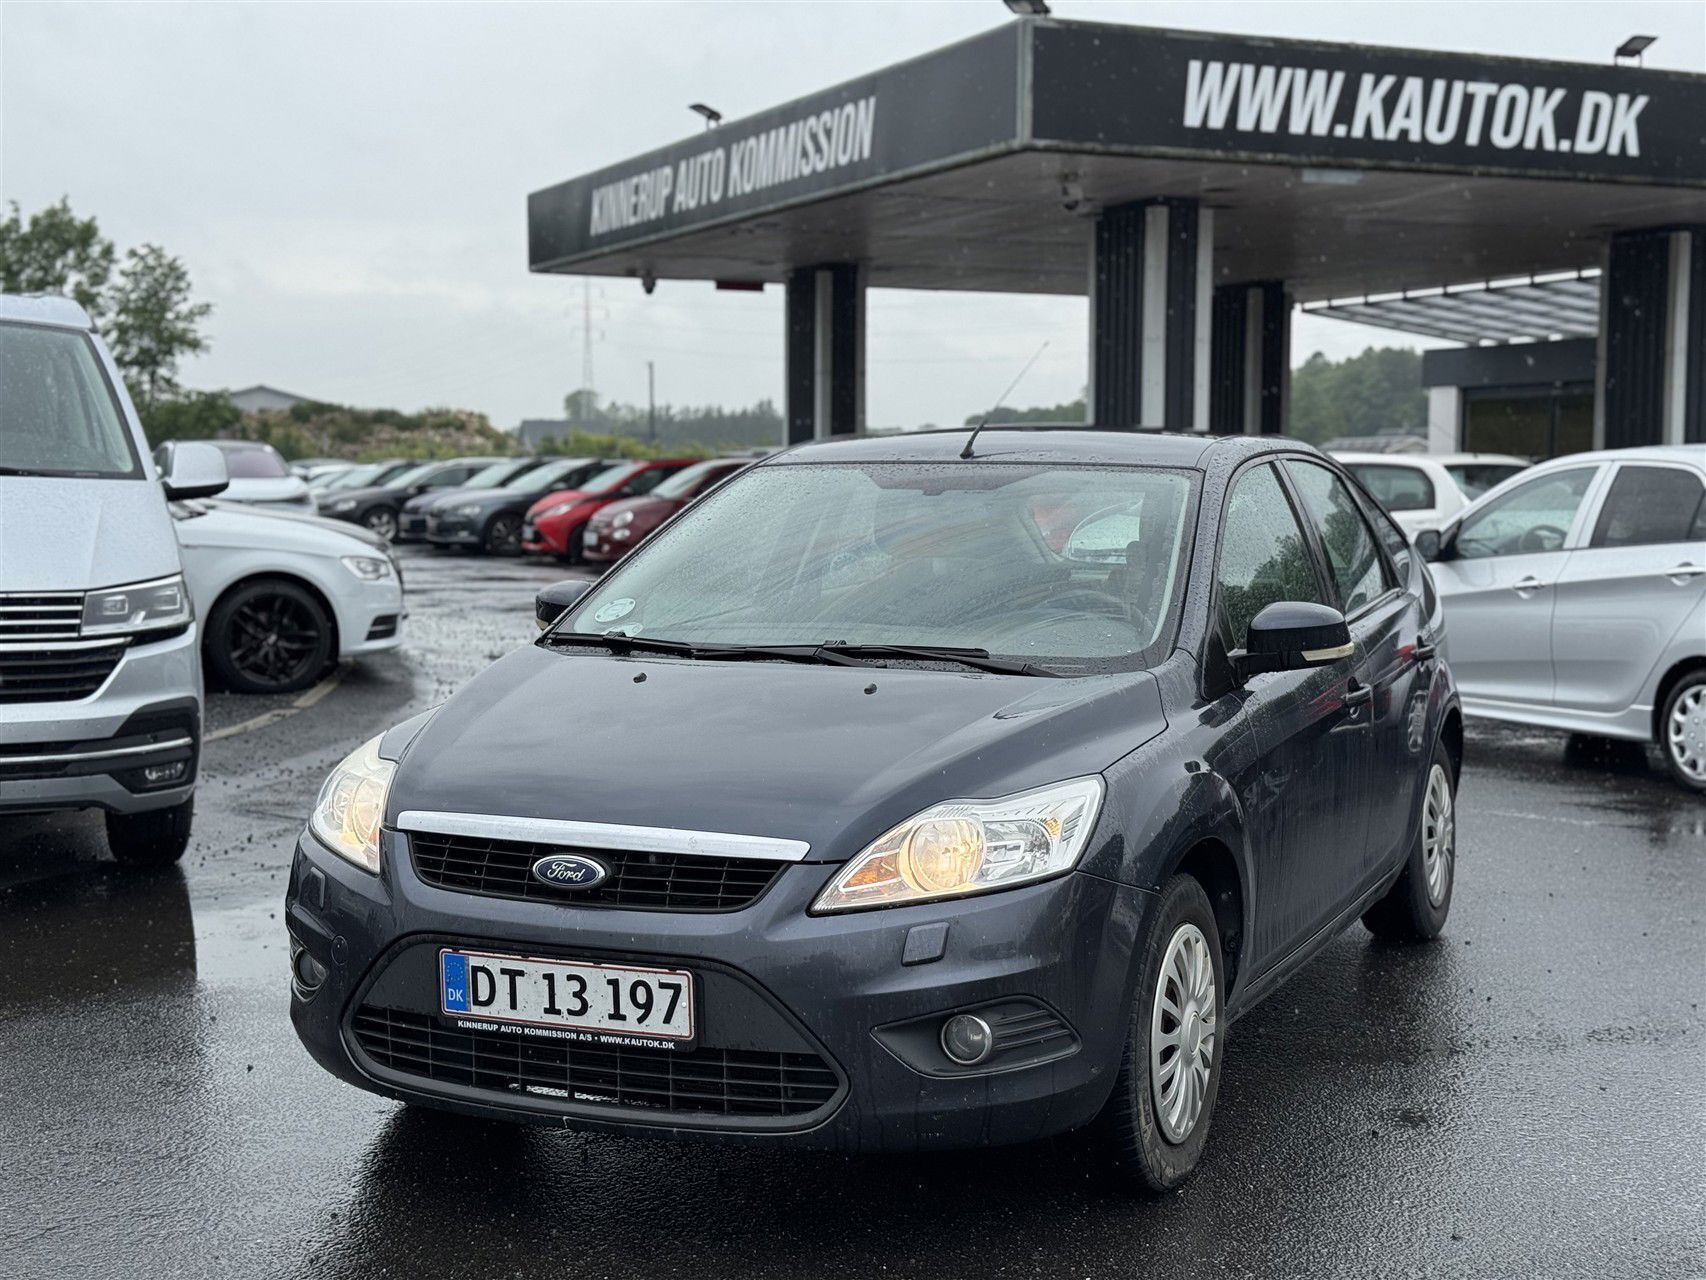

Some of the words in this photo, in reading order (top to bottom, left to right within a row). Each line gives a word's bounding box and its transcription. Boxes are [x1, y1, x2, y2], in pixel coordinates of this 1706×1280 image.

[1183, 59, 1649, 158] WWW.KAUTOK.DK
[590, 165, 674, 236] KINNERUP
[673, 148, 726, 213] AUTO
[727, 96, 876, 198] KOMMISSION
[547, 861, 586, 881] Ford
[448, 988, 464, 1003] DK
[470, 964, 525, 1011] DT
[542, 973, 588, 1017] 13
[606, 977, 683, 1025] 197
[457, 1020, 498, 1031] KINNERUP
[500, 1025, 522, 1034] AUTO
[524, 1028, 577, 1040] KOMMISSION
[579, 1033, 593, 1042] A/S
[600, 1035, 675, 1049] WWW.KAUTOK.DK
